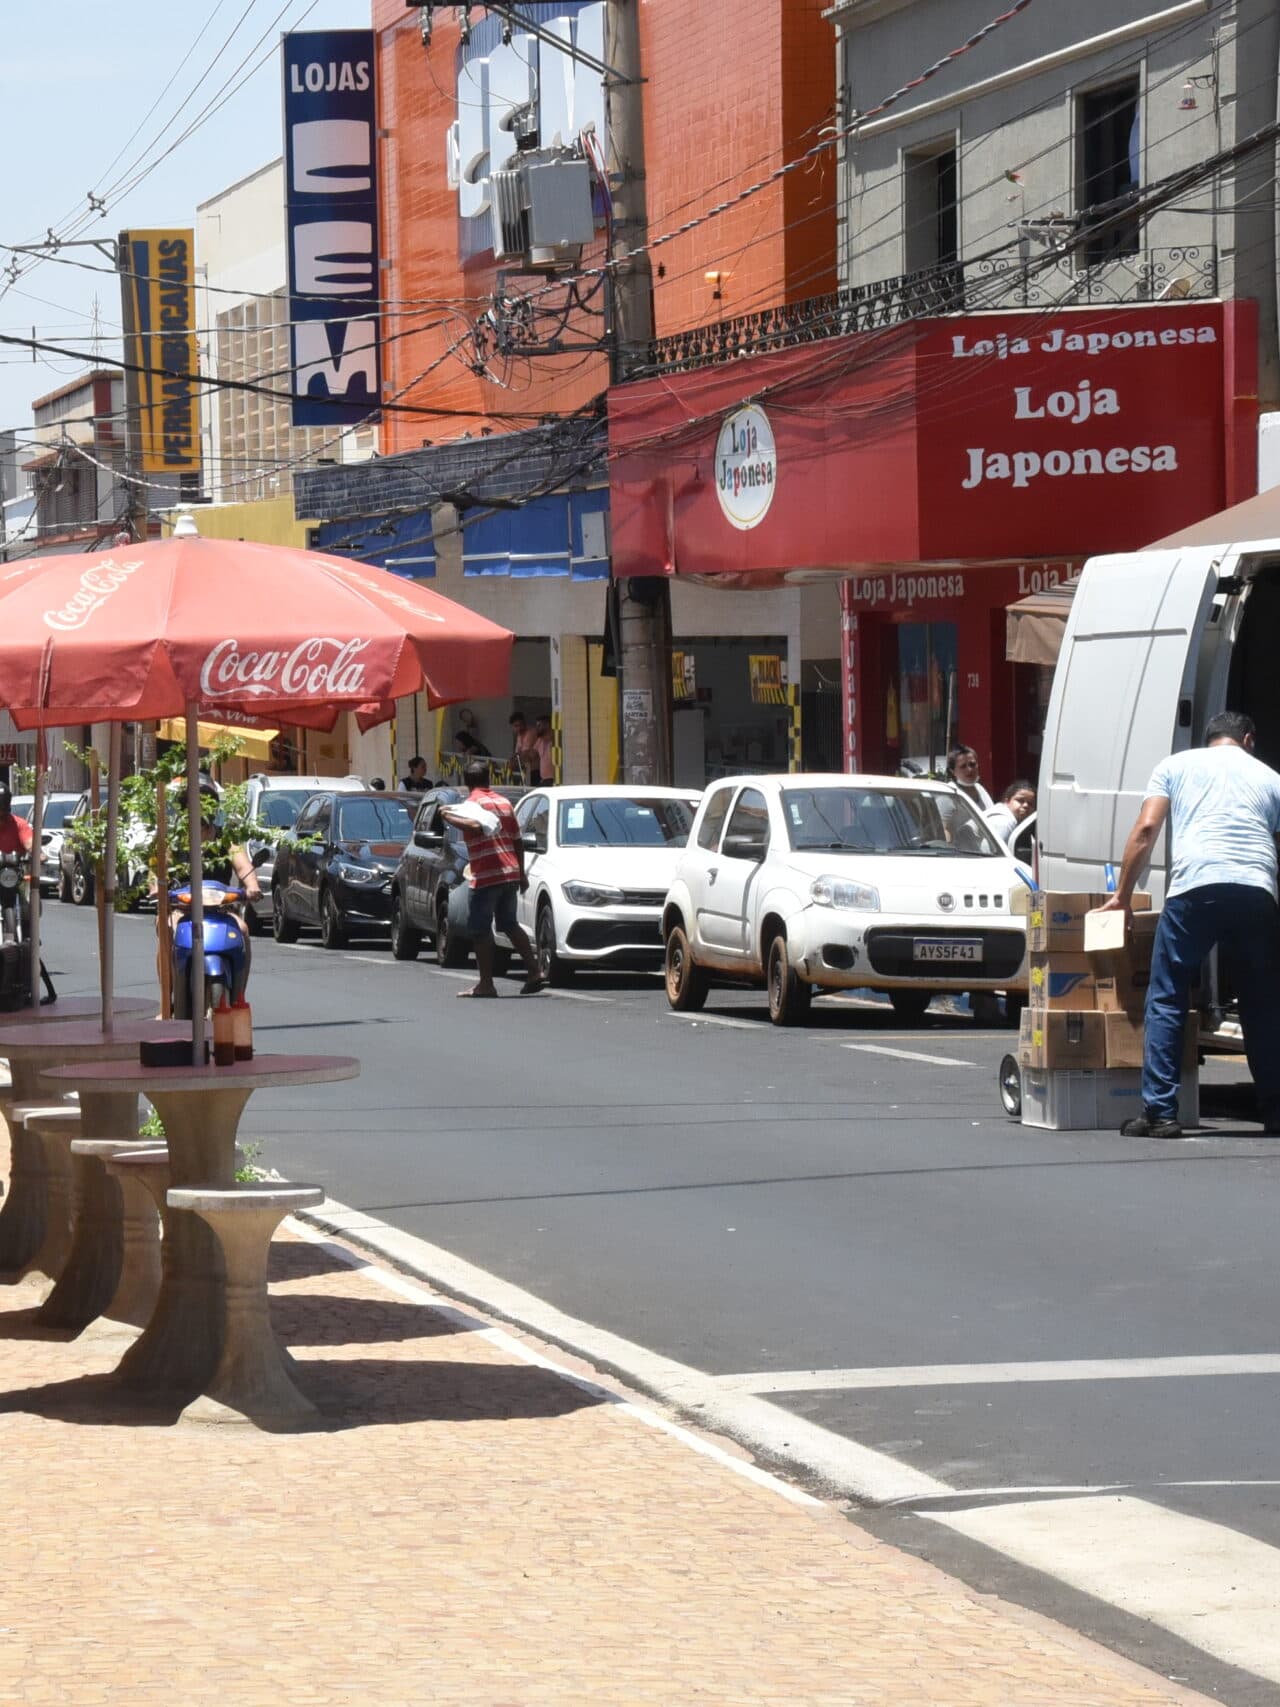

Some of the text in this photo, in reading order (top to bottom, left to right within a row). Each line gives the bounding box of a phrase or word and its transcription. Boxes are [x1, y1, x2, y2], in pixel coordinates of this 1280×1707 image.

[291, 61, 370, 94] LOJAS
[292, 119, 377, 395] CEM
[158, 238, 193, 465] PERNAMBUCANAS
[952, 326, 1217, 360] Loja Japonesa
[1014, 379, 1120, 424] Loja
[731, 419, 758, 458] Loja
[720, 460, 772, 497] Japonesa
[961, 444, 1178, 489] Japonesa
[852, 572, 964, 606] Loja Japonesa
[200, 637, 371, 696] Coca-Cola
[920, 946, 975, 960] AYS5F41
